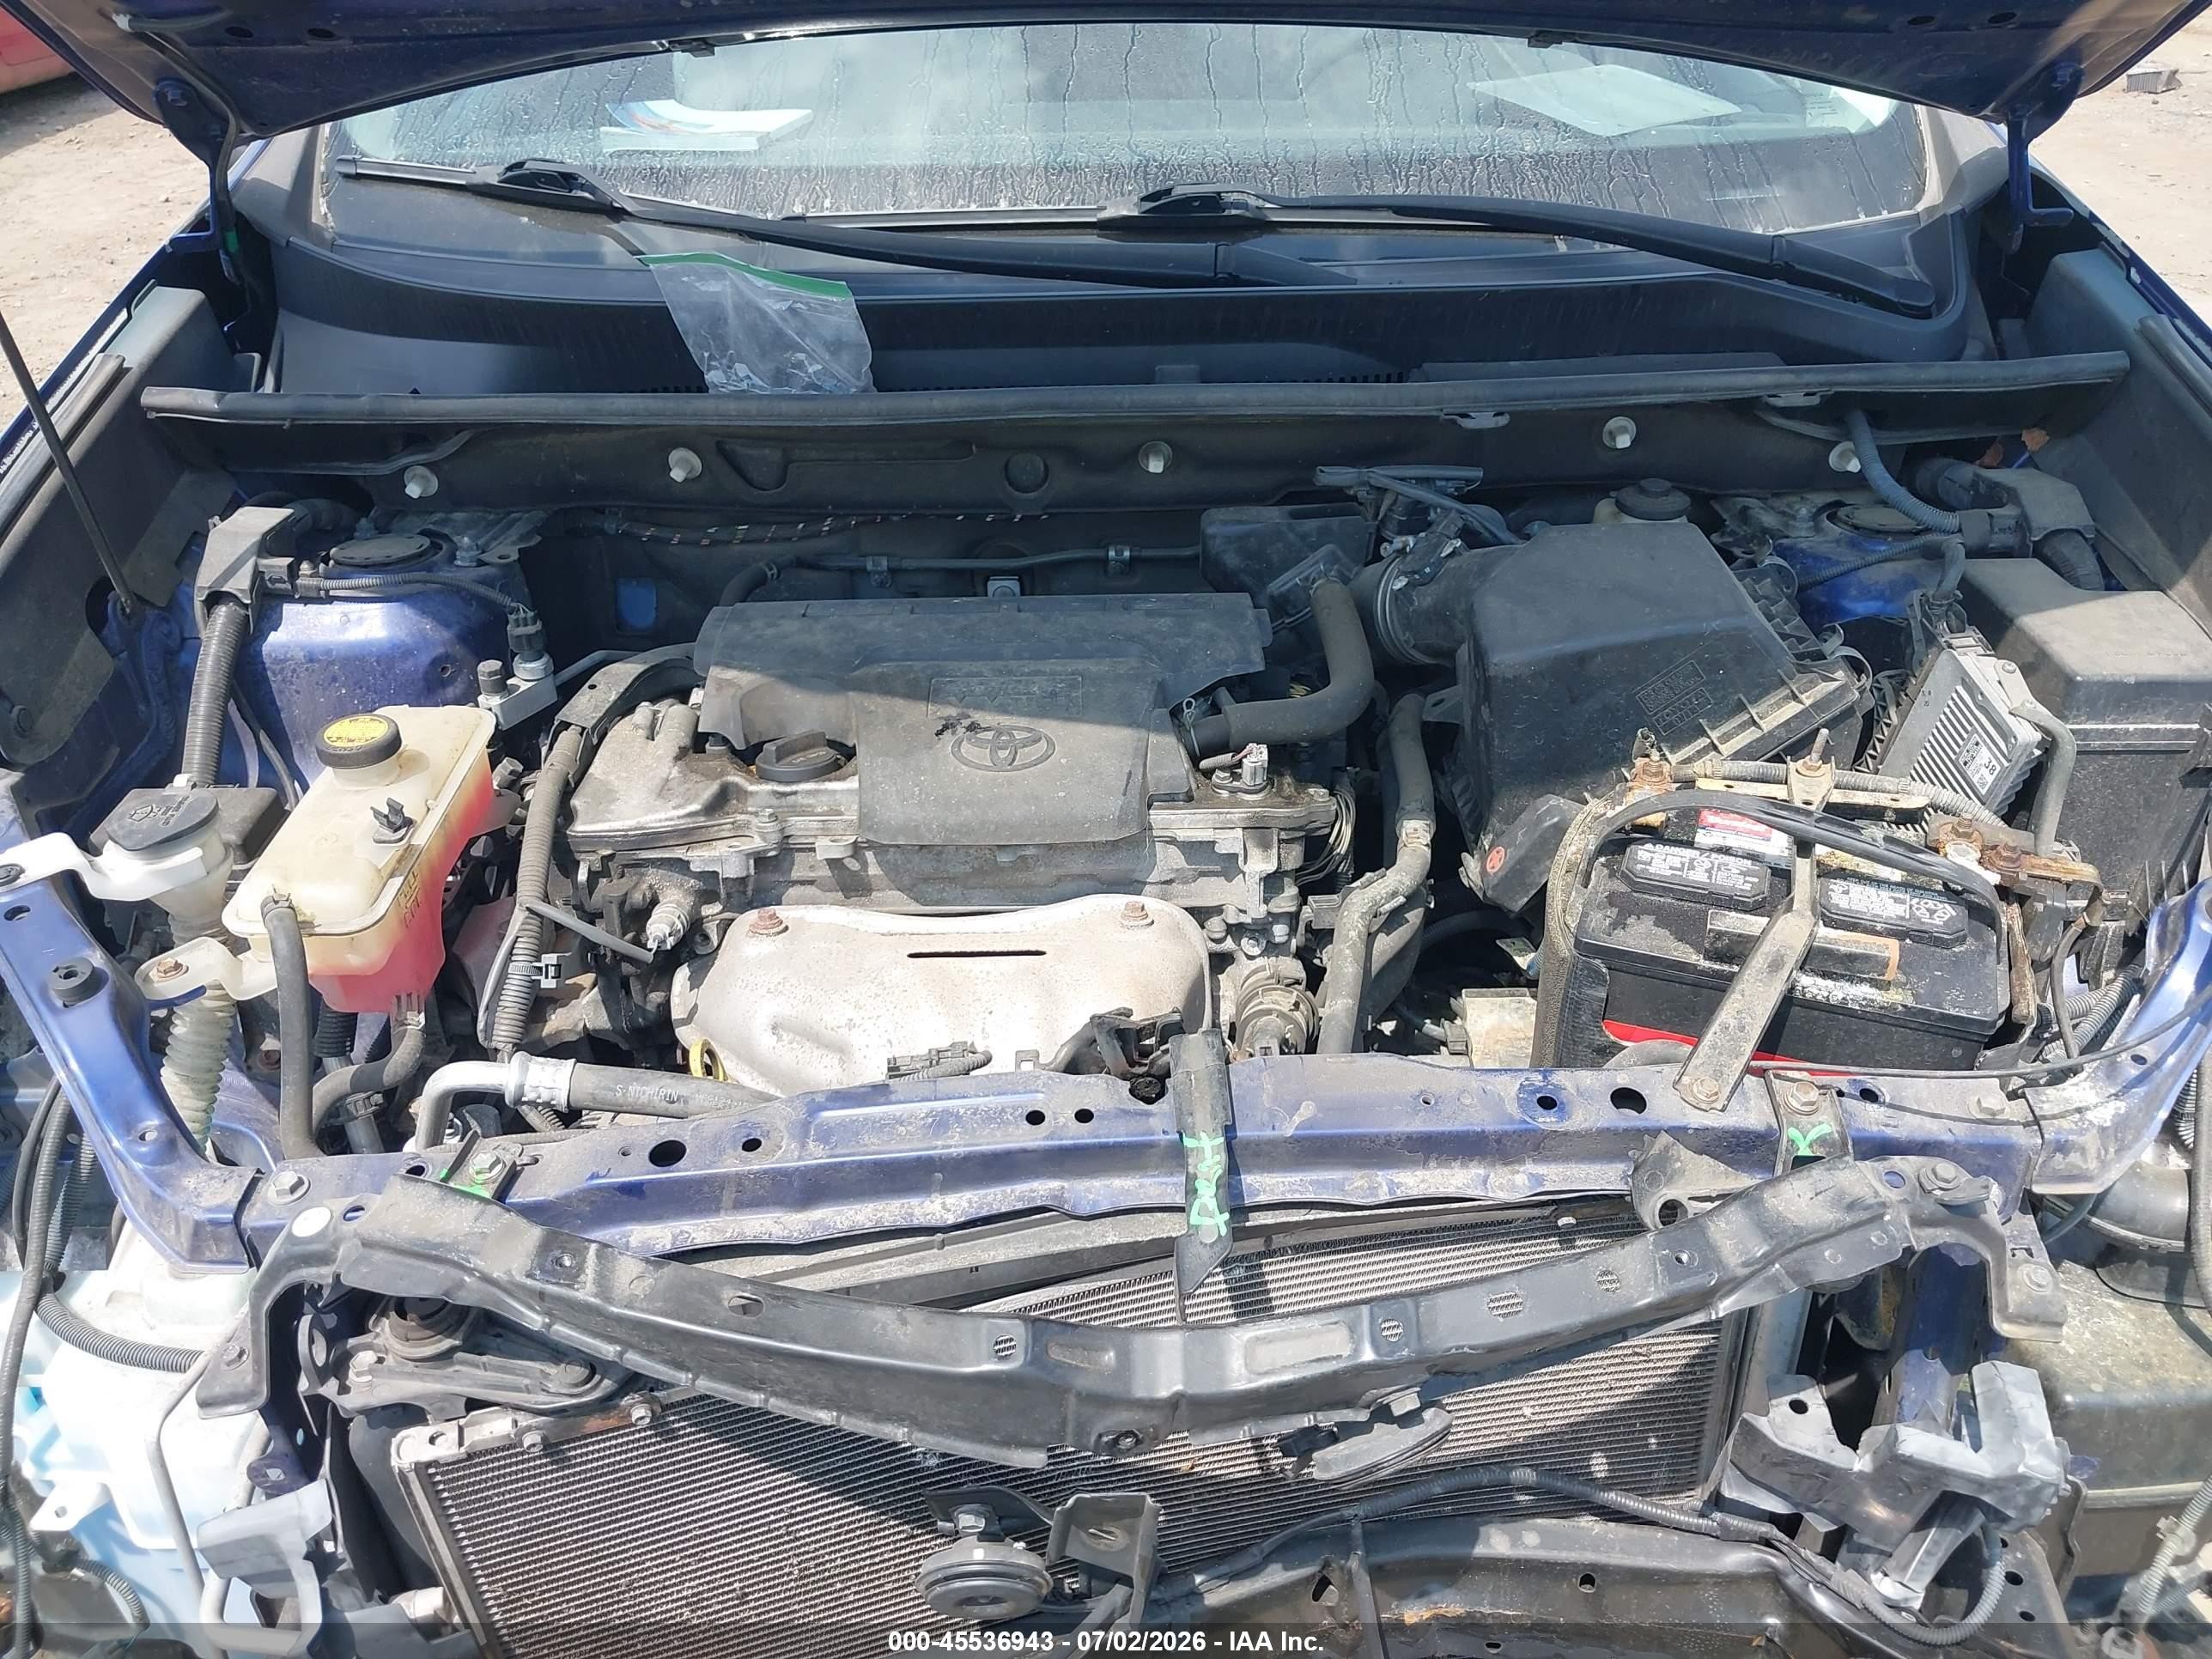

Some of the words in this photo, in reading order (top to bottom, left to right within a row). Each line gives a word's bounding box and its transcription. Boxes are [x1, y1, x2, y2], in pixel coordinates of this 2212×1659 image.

[1984, 757, 1996, 775] 38
[1655, 843, 1700, 859] DANGER
[1711, 853, 1753, 866] POISON
